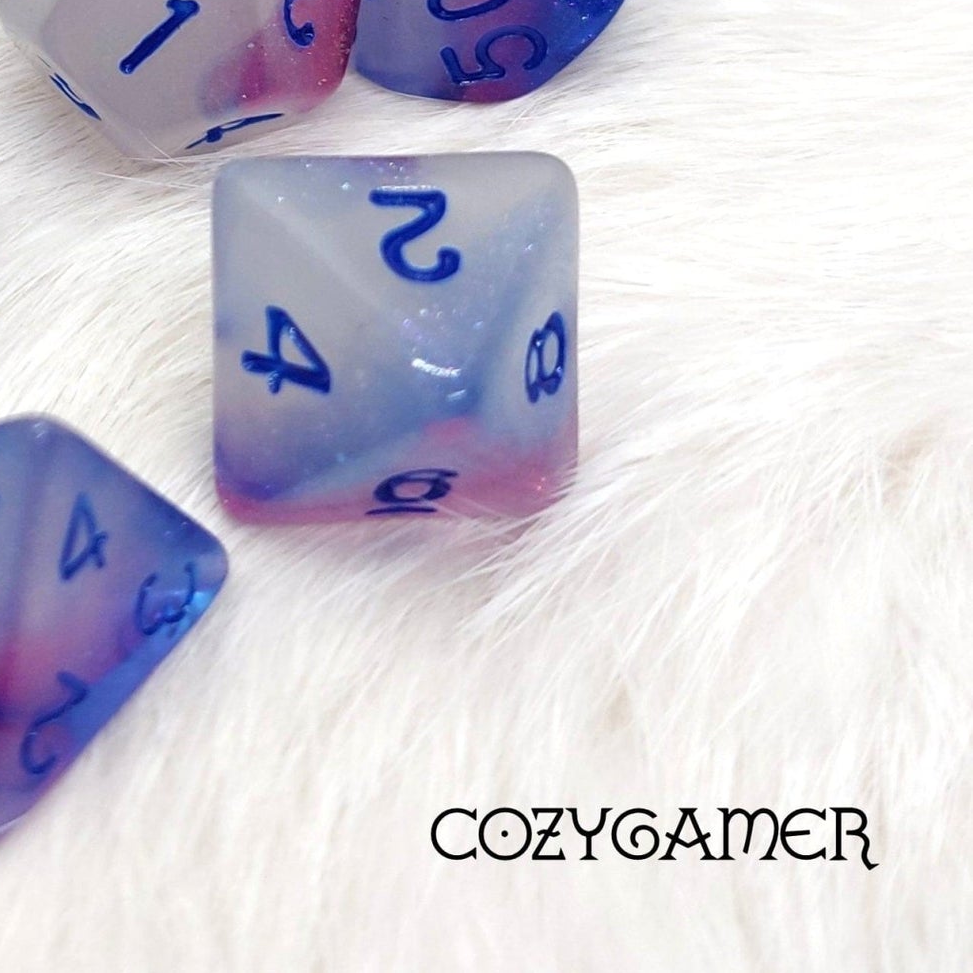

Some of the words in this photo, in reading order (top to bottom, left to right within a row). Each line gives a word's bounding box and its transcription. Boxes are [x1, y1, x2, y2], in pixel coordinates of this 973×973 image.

[368, 188, 462, 284] 2
[240, 305, 332, 395] 4
[525, 310, 567, 404] 8
[59, 490, 108, 581] 4
[135, 561, 197, 637] 3
[19, 670, 90, 775] 2
